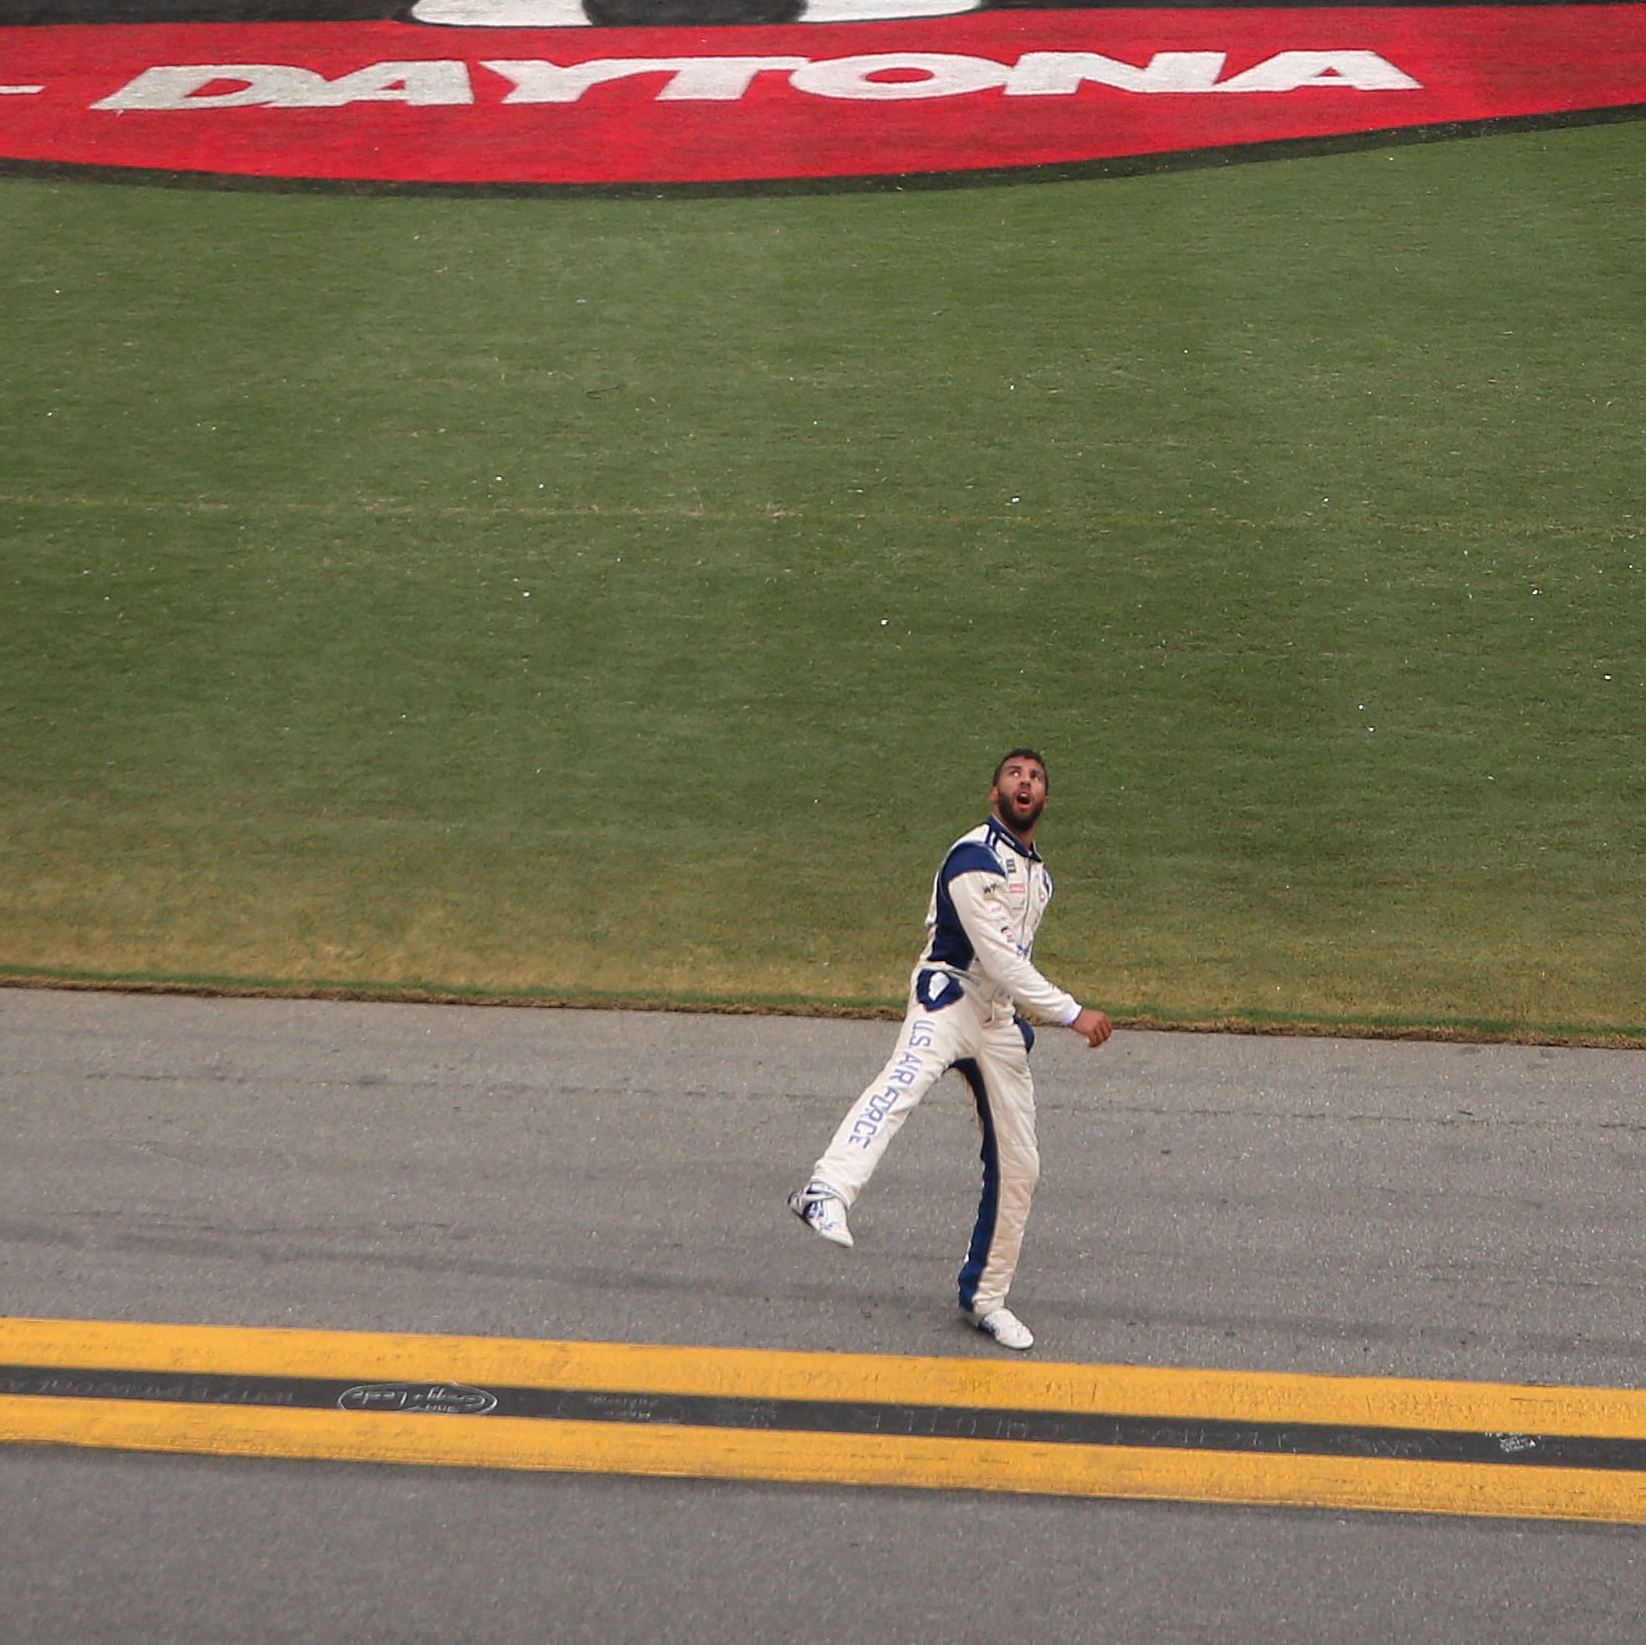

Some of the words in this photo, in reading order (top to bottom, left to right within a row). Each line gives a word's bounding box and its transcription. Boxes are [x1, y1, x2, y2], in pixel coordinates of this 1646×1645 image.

[88, 50, 1423, 113] DAYTONA
[889, 1051, 923, 1086] AIR
[850, 1084, 901, 1150] FORCE
